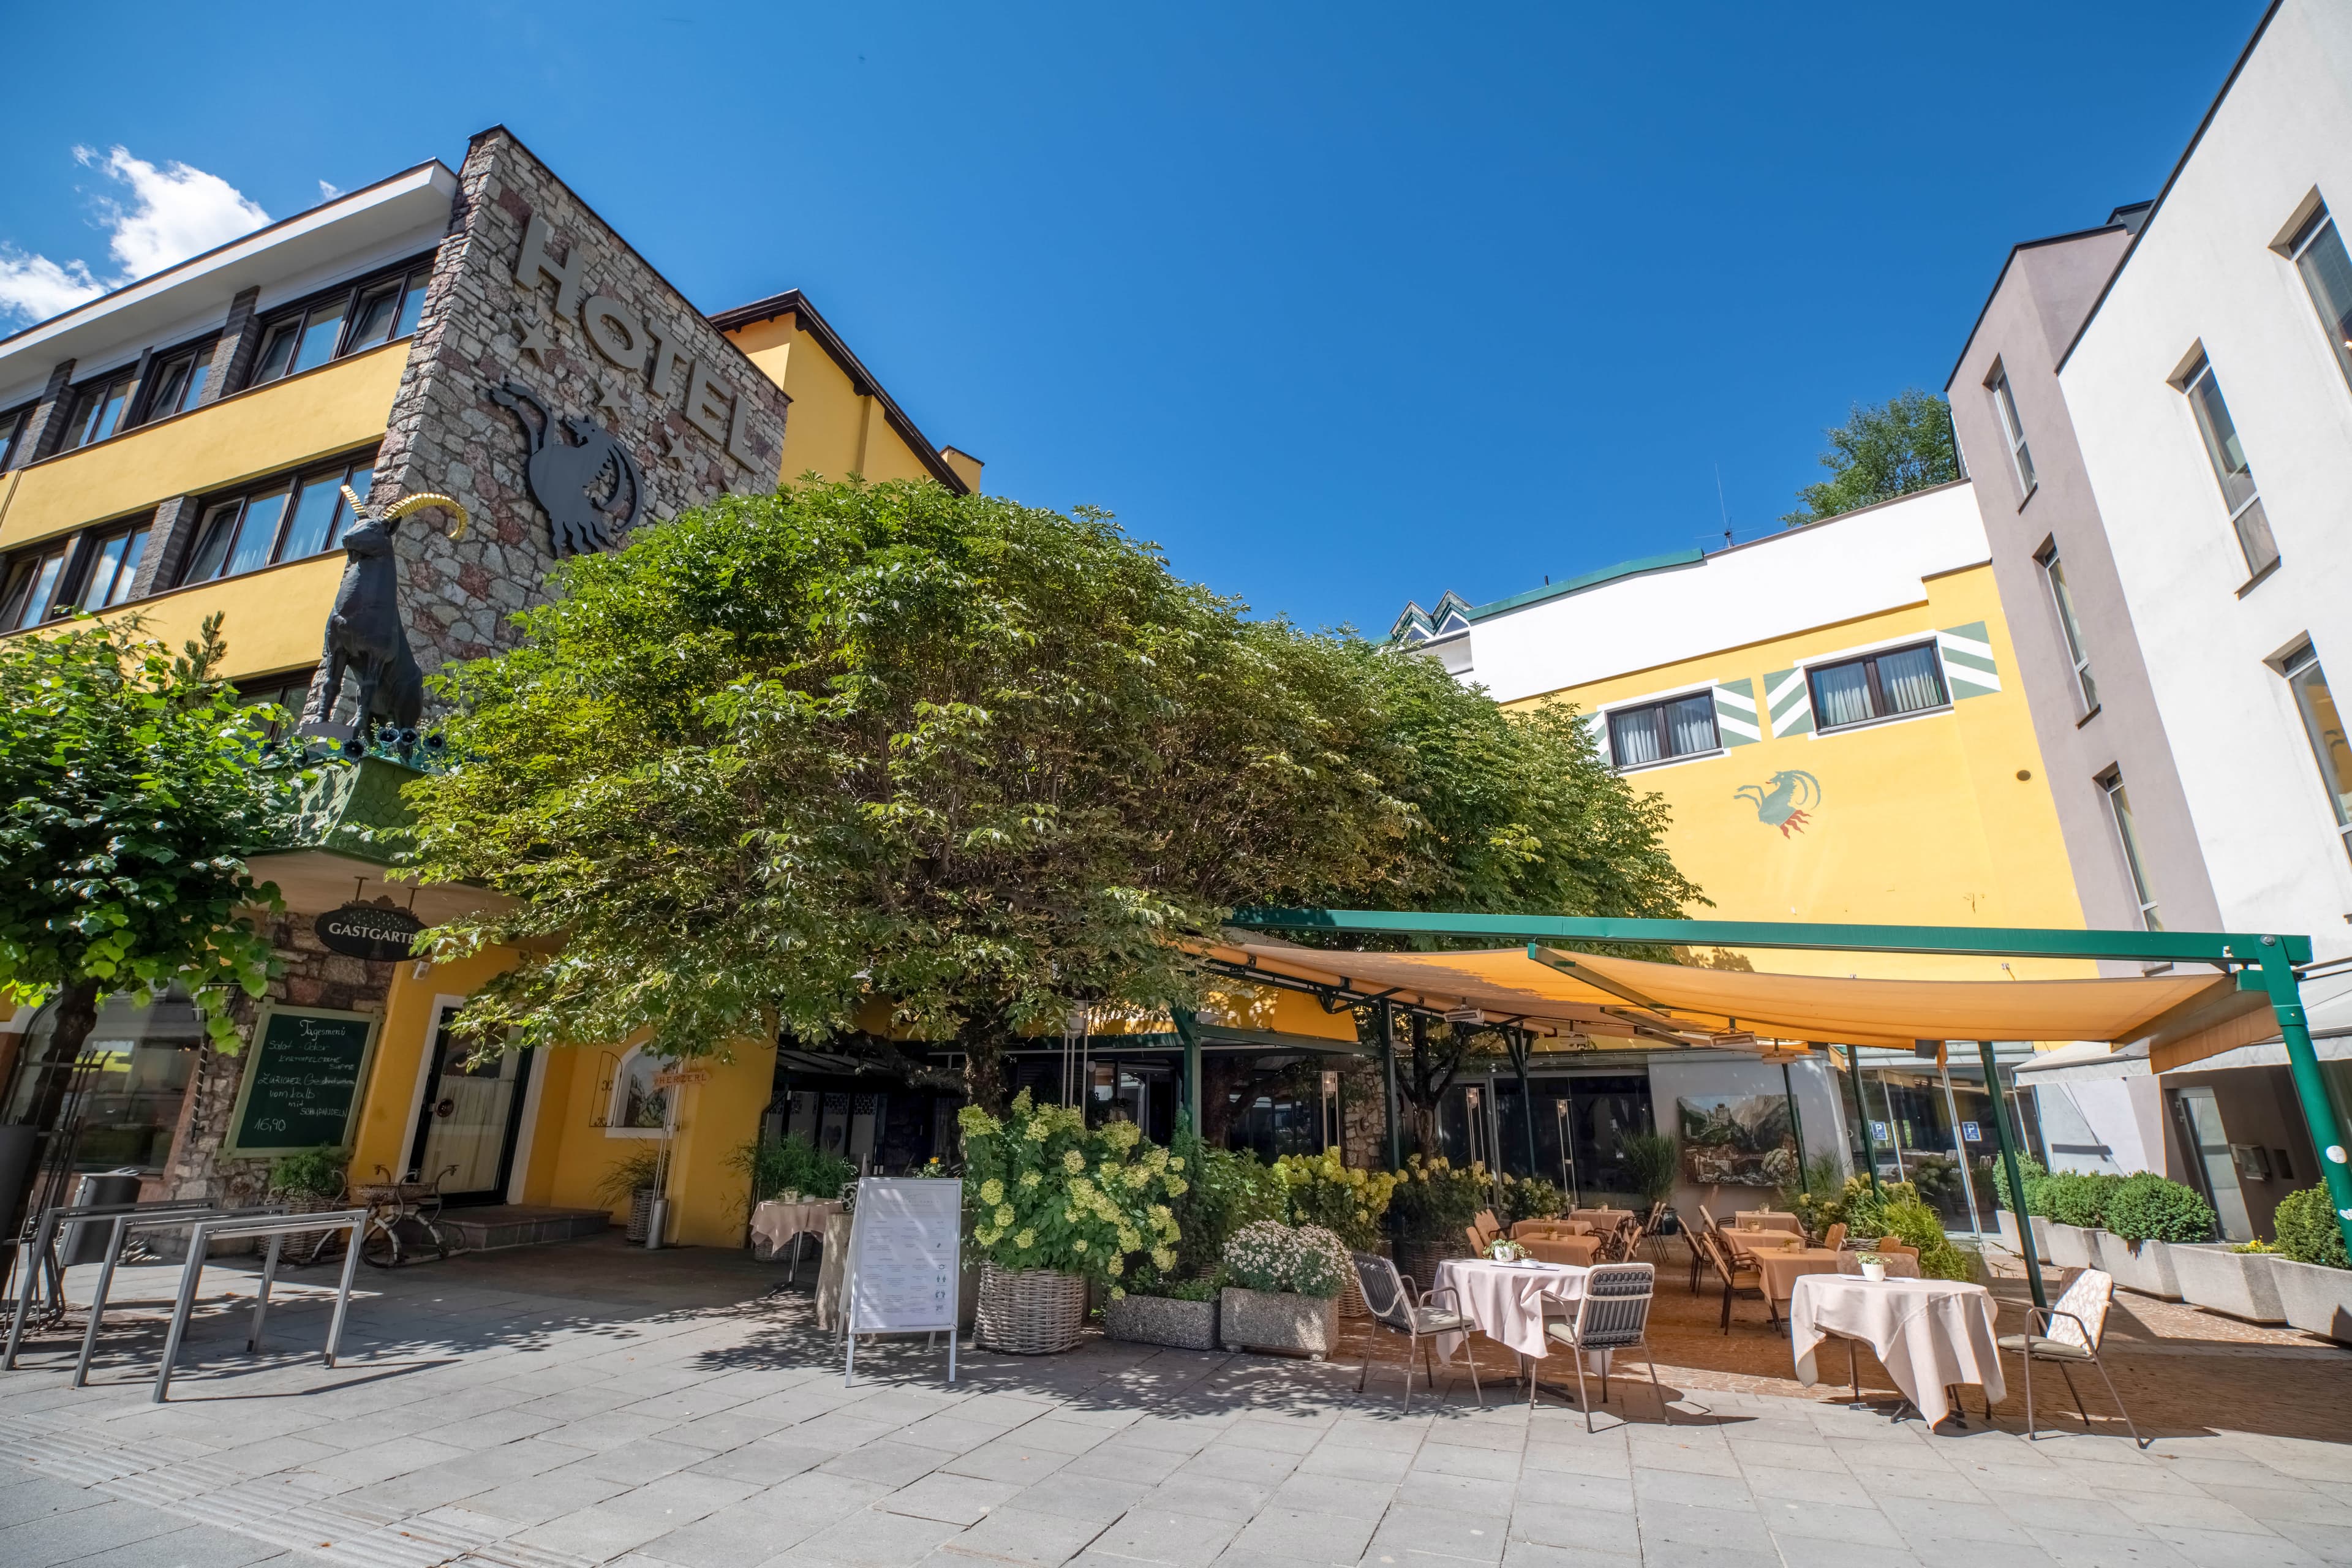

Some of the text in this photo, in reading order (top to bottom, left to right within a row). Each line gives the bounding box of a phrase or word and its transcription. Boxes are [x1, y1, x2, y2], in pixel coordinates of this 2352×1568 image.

[514, 214, 764, 474] HOTEL
[328, 922, 415, 944] GASTGARTE
[659, 1074, 707, 1084] HERZERL
[270, 1090, 288, 1098] vom
[254, 1118, 287, 1132] 16,90
[1875, 1123, 1883, 1133] P
[1967, 1124, 1975, 1133] P
